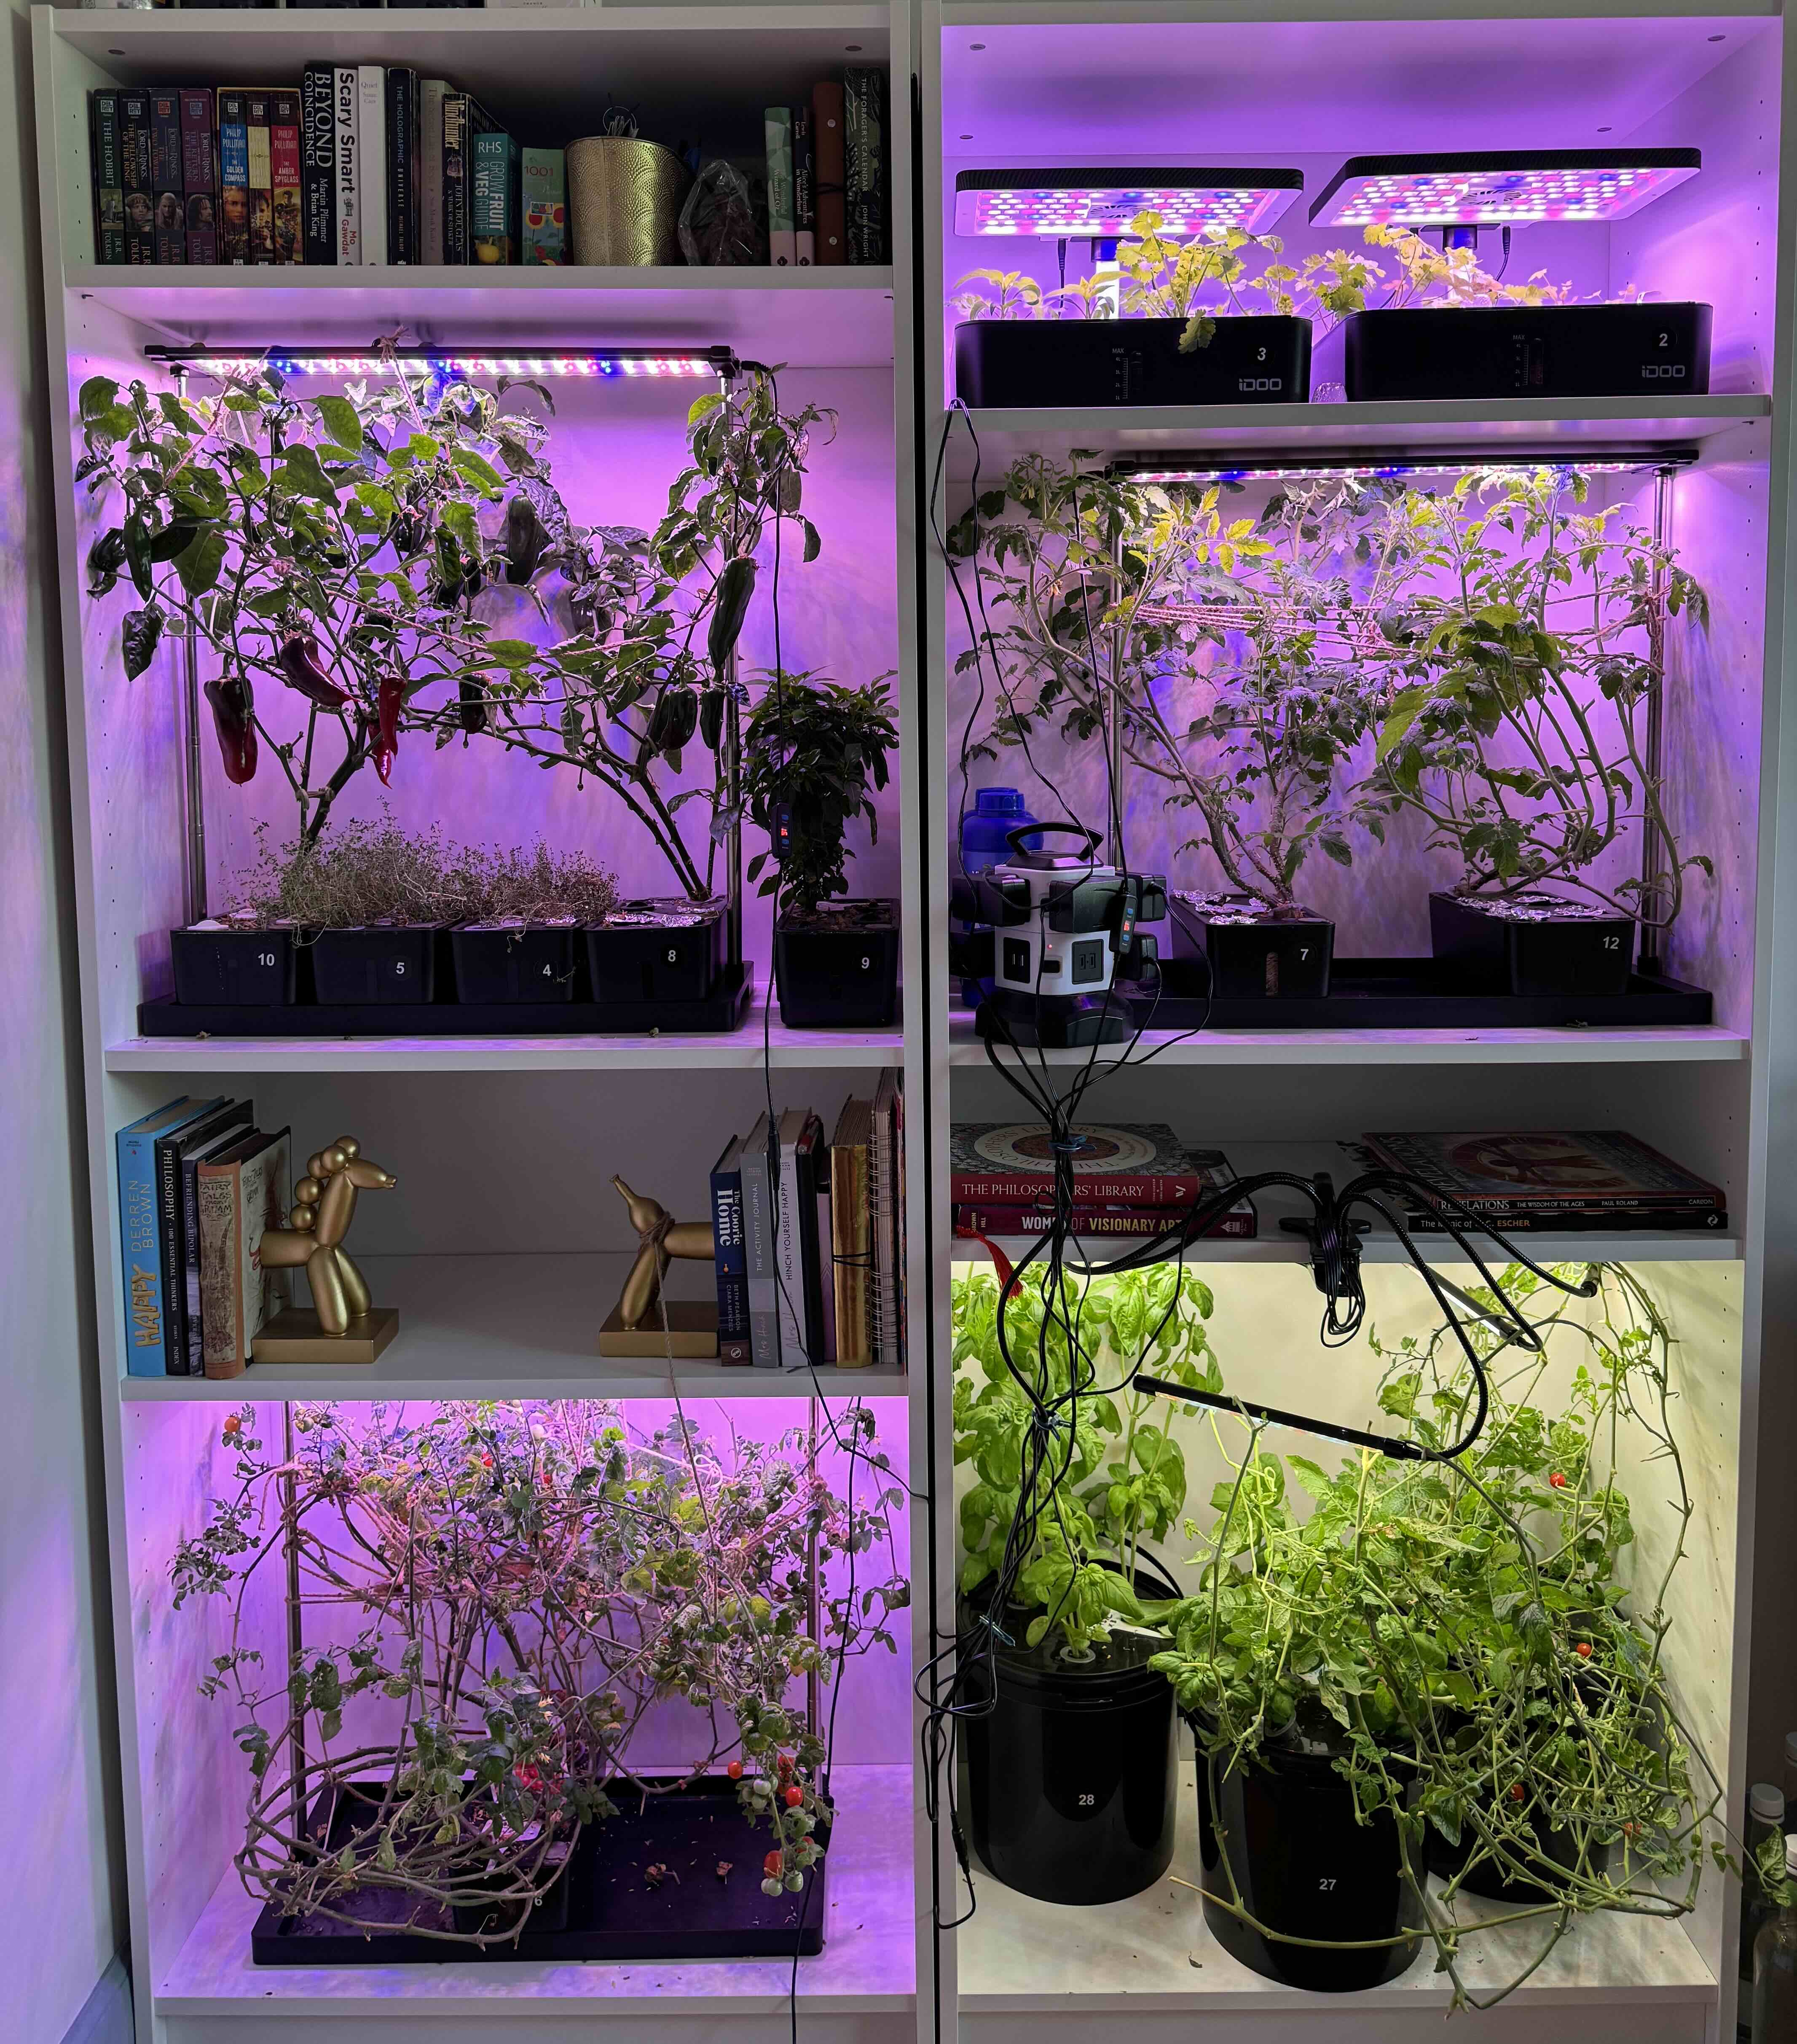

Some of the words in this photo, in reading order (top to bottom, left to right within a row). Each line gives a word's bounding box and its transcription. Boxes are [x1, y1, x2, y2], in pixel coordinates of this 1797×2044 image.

[337, 72, 354, 128] Scary
[104, 121, 112, 142] THE
[304, 71, 315, 167] COINCIDENCE
[315, 72, 333, 168] BEYOND
[445, 99, 465, 150] Mindhunter
[122, 132, 129, 142] OF
[223, 138, 246, 148] PULLMAN
[225, 128, 242, 137] PHILIP
[274, 140, 297, 149] PULLMAN
[277, 129, 293, 139] PHILIP
[478, 141, 502, 154] RHS
[104, 145, 115, 186] HOBBIT
[129, 140, 137, 188] FELLOWSHIP
[341, 134, 355, 193] Smart
[475, 161, 489, 171] &
[524, 166, 553, 176] 1001
[225, 174, 246, 183] COMPASS
[475, 171, 489, 196] VEG
[489, 161, 505, 193] GROW
[311, 193, 319, 215] Brian
[319, 177, 330, 206] Martin
[454, 184, 463, 207] JOHN
[475, 199, 489, 230] GUIDE
[489, 193, 505, 231] FRUIT
[775, 201, 780, 210] Oz
[310, 217, 321, 237] King
[320, 209, 330, 243] Plimmer
[342, 219, 350, 256] Gawdat
[349, 231, 357, 245] Mo
[454, 210, 463, 252] DOUGLAS
[131, 237, 139, 264] TOLKI
[161, 236, 169, 264] TOLKI
[192, 238, 202, 264] TOLKI
[1659, 333, 1668, 346] 2
[1257, 347, 1266, 361] 3
[1300, 948, 1309, 961] 7
[1603, 936, 1620, 950] 12
[257, 953, 275, 967] 10
[395, 962, 405, 975] 5
[668, 950, 676, 962] 8
[861, 957, 870, 969] 9
[542, 964, 552, 977] 4
[163, 1149, 175, 1220] PHILOSOPHY
[781, 1182, 789, 1208] HAPPY
[961, 1183, 989, 1195] THE
[991, 1183, 1092, 1195] PHILOSOPRS'
[1094, 1184, 1144, 1197] LIBRARY
[185, 1173, 194, 1227] BEFRIENDING
[751, 1183, 760, 1217] JOURNAL
[1440, 1200, 1510, 1210] RELATIONS
[128, 1180, 142, 1252] DERREN
[140, 1184, 154, 1248] BROWN
[717, 1189, 734, 1246] Home
[731, 1206, 743, 1245] Coorie
[1021, 1216, 1066, 1230] WOM
[1072, 1217, 1086, 1230] OF
[1089, 1217, 1156, 1232] VISIONARY
[1464, 1220, 1472, 1228] of
[783, 1210, 791, 1251] YOURSELF
[168, 1241, 177, 1276] ESSENTIAL
[188, 1229, 196, 1263] BIPOLAR
[784, 1254, 792, 1280] HINCH
[131, 1263, 162, 1348] HAPPY
[1078, 1794, 1094, 1805] 28
[1319, 1878, 1337, 1891] 27
